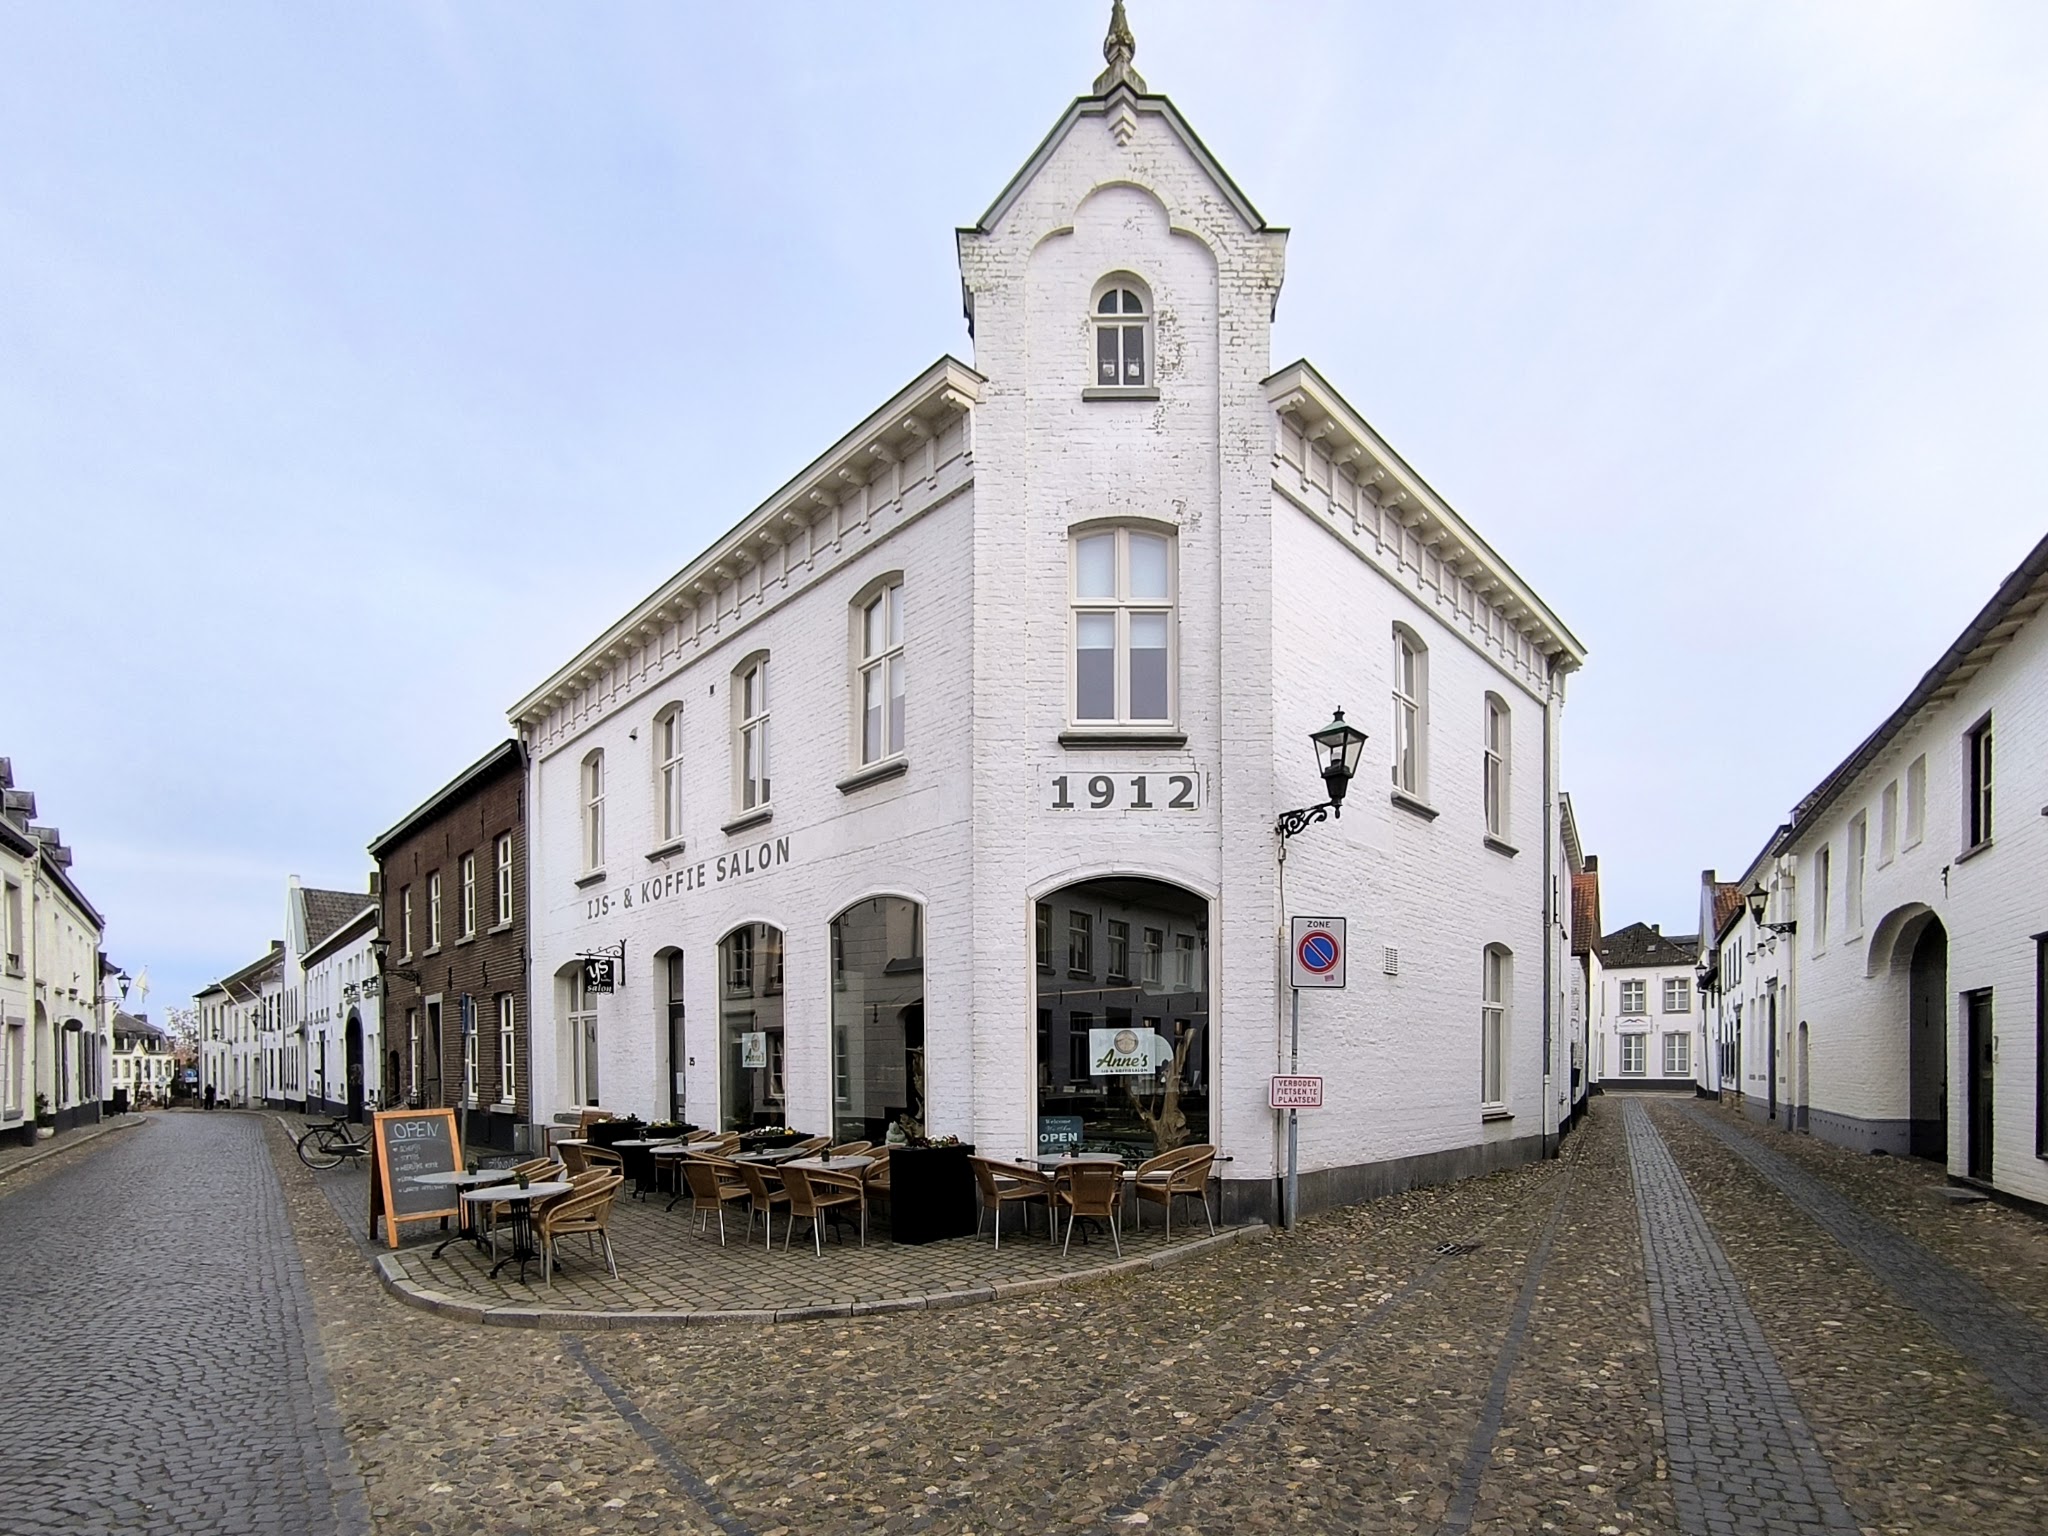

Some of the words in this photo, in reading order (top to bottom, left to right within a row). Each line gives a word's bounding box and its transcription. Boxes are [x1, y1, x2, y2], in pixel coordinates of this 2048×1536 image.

[1052, 775, 1194, 809] 1912
[587, 895, 616, 920] IJS-
[623, 887, 633, 909] &
[641, 863, 706, 904] KOFFIE
[716, 836, 791, 882] SALON
[1307, 920, 1331, 928] ZONE
[587, 984, 612, 992] salon
[1096, 1048, 1148, 1068] Anne's
[394, 1121, 439, 1138] OPEN
[1040, 1132, 1078, 1142] OPEN
